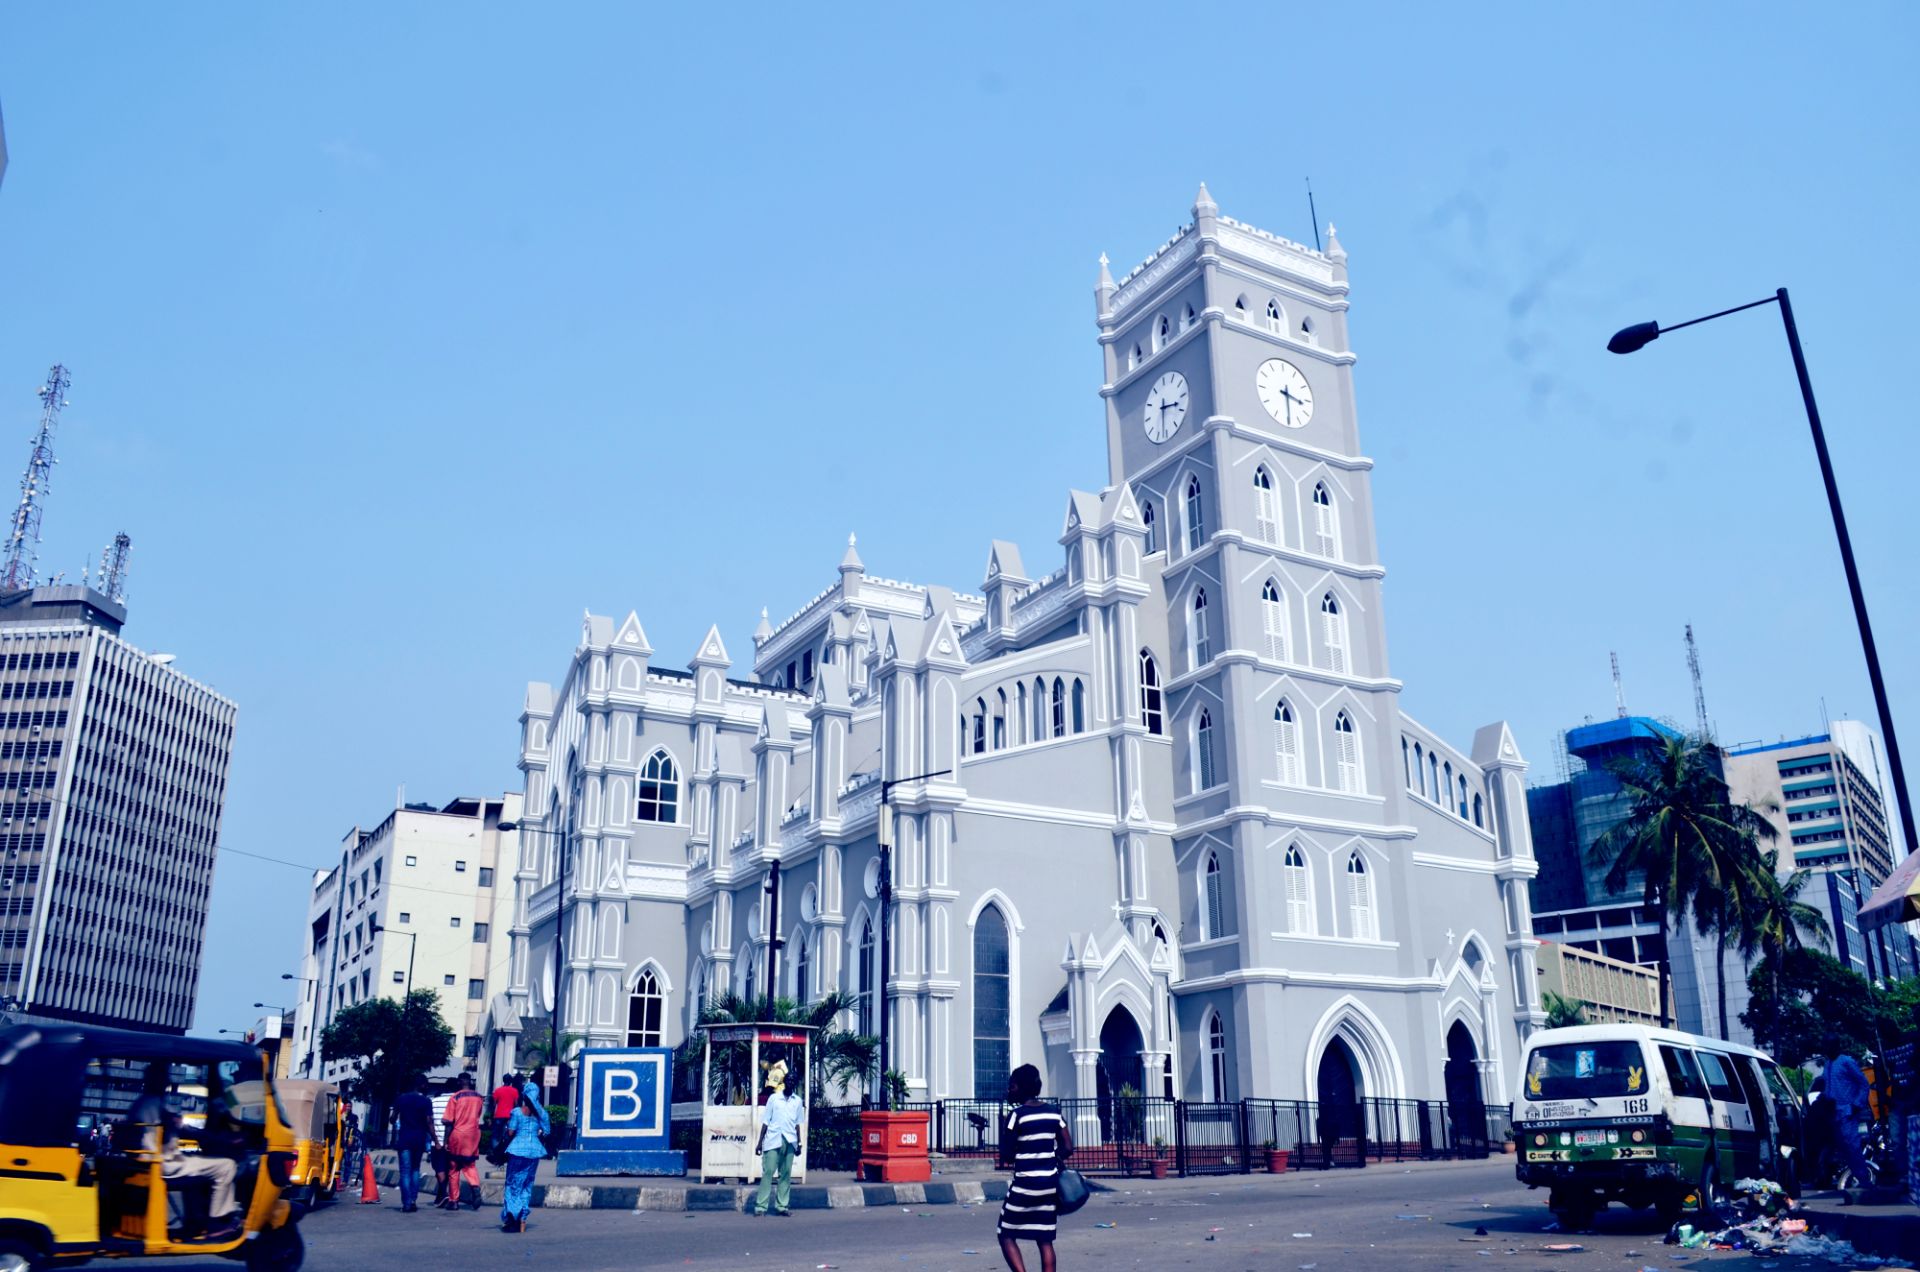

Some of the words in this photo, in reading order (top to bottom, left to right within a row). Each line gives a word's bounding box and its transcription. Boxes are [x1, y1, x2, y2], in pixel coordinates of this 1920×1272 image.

[771, 1030, 793, 1040] POLICE
[603, 1069, 642, 1121] B
[1624, 1098, 1648, 1114] 168
[710, 1134, 747, 1142] MIKANO
[901, 1133, 918, 1144] CBD
